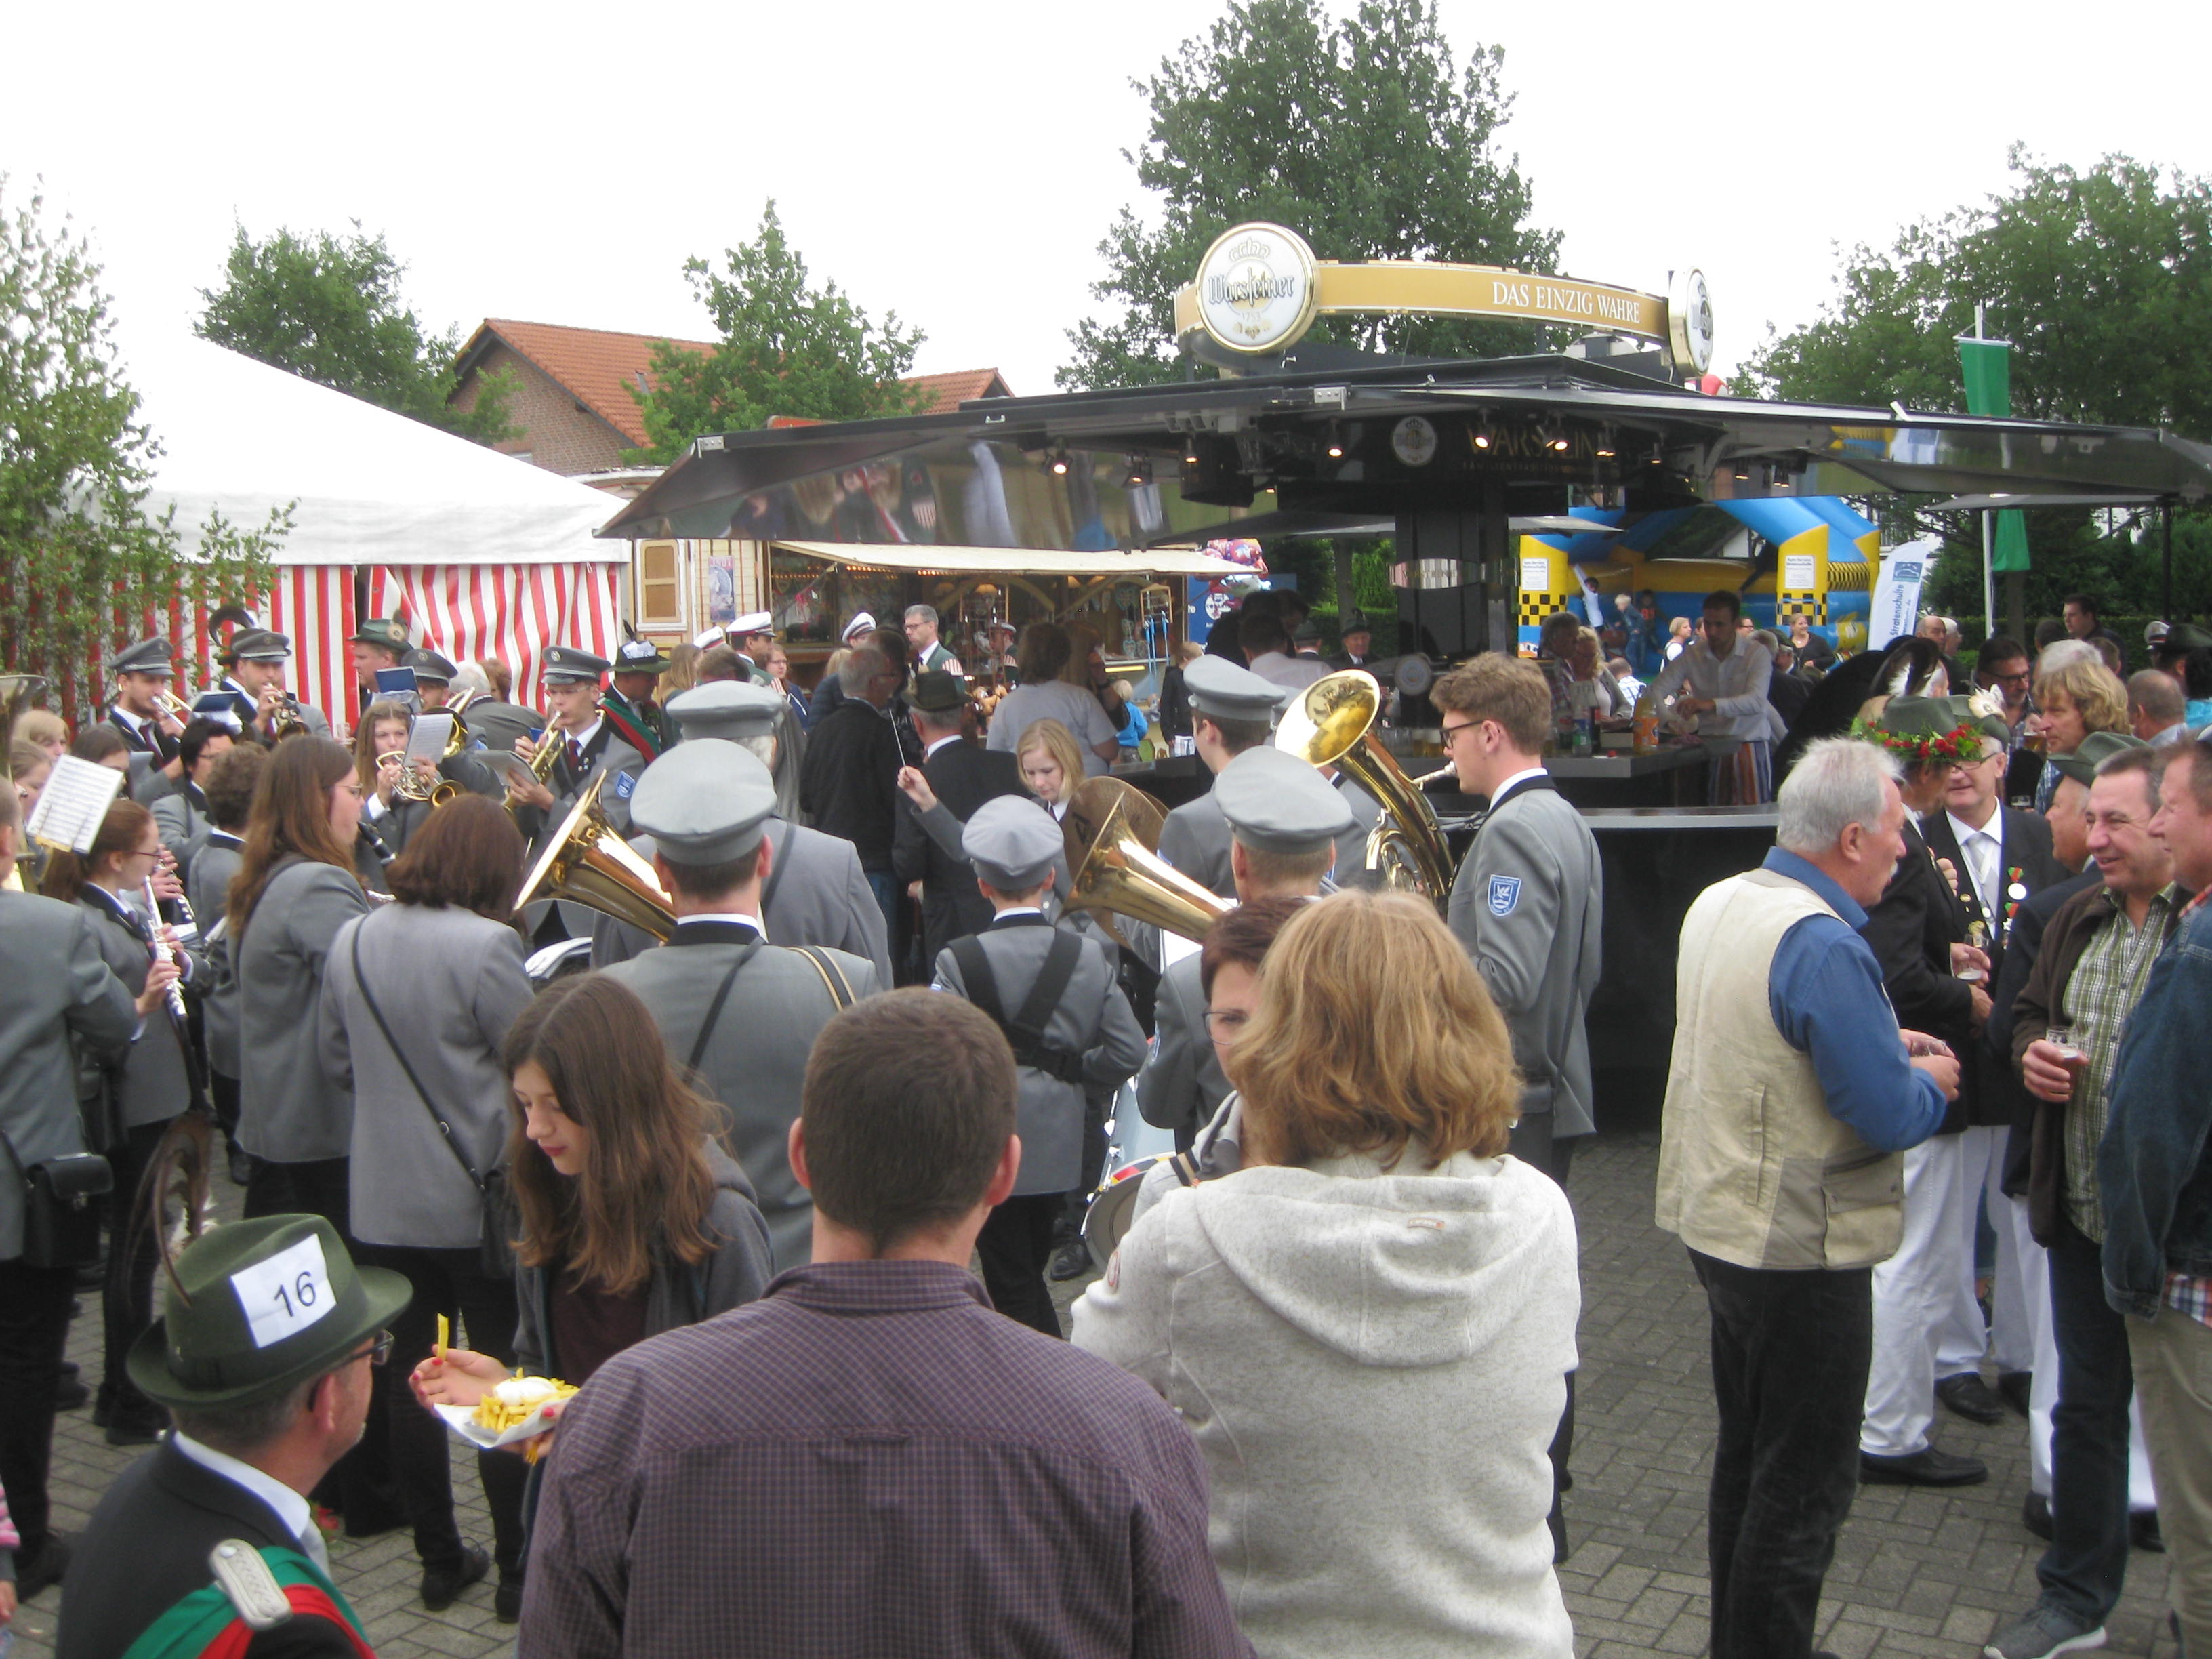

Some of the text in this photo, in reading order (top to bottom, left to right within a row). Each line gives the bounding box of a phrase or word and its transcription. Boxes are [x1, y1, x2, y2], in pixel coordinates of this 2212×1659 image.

[1208, 266, 1295, 308] Warsteiner
[1492, 281, 1641, 324] DAS EINZIG WAHRE
[1889, 584, 1905, 636] Stratenschulte
[274, 1271, 316, 1317] 16
